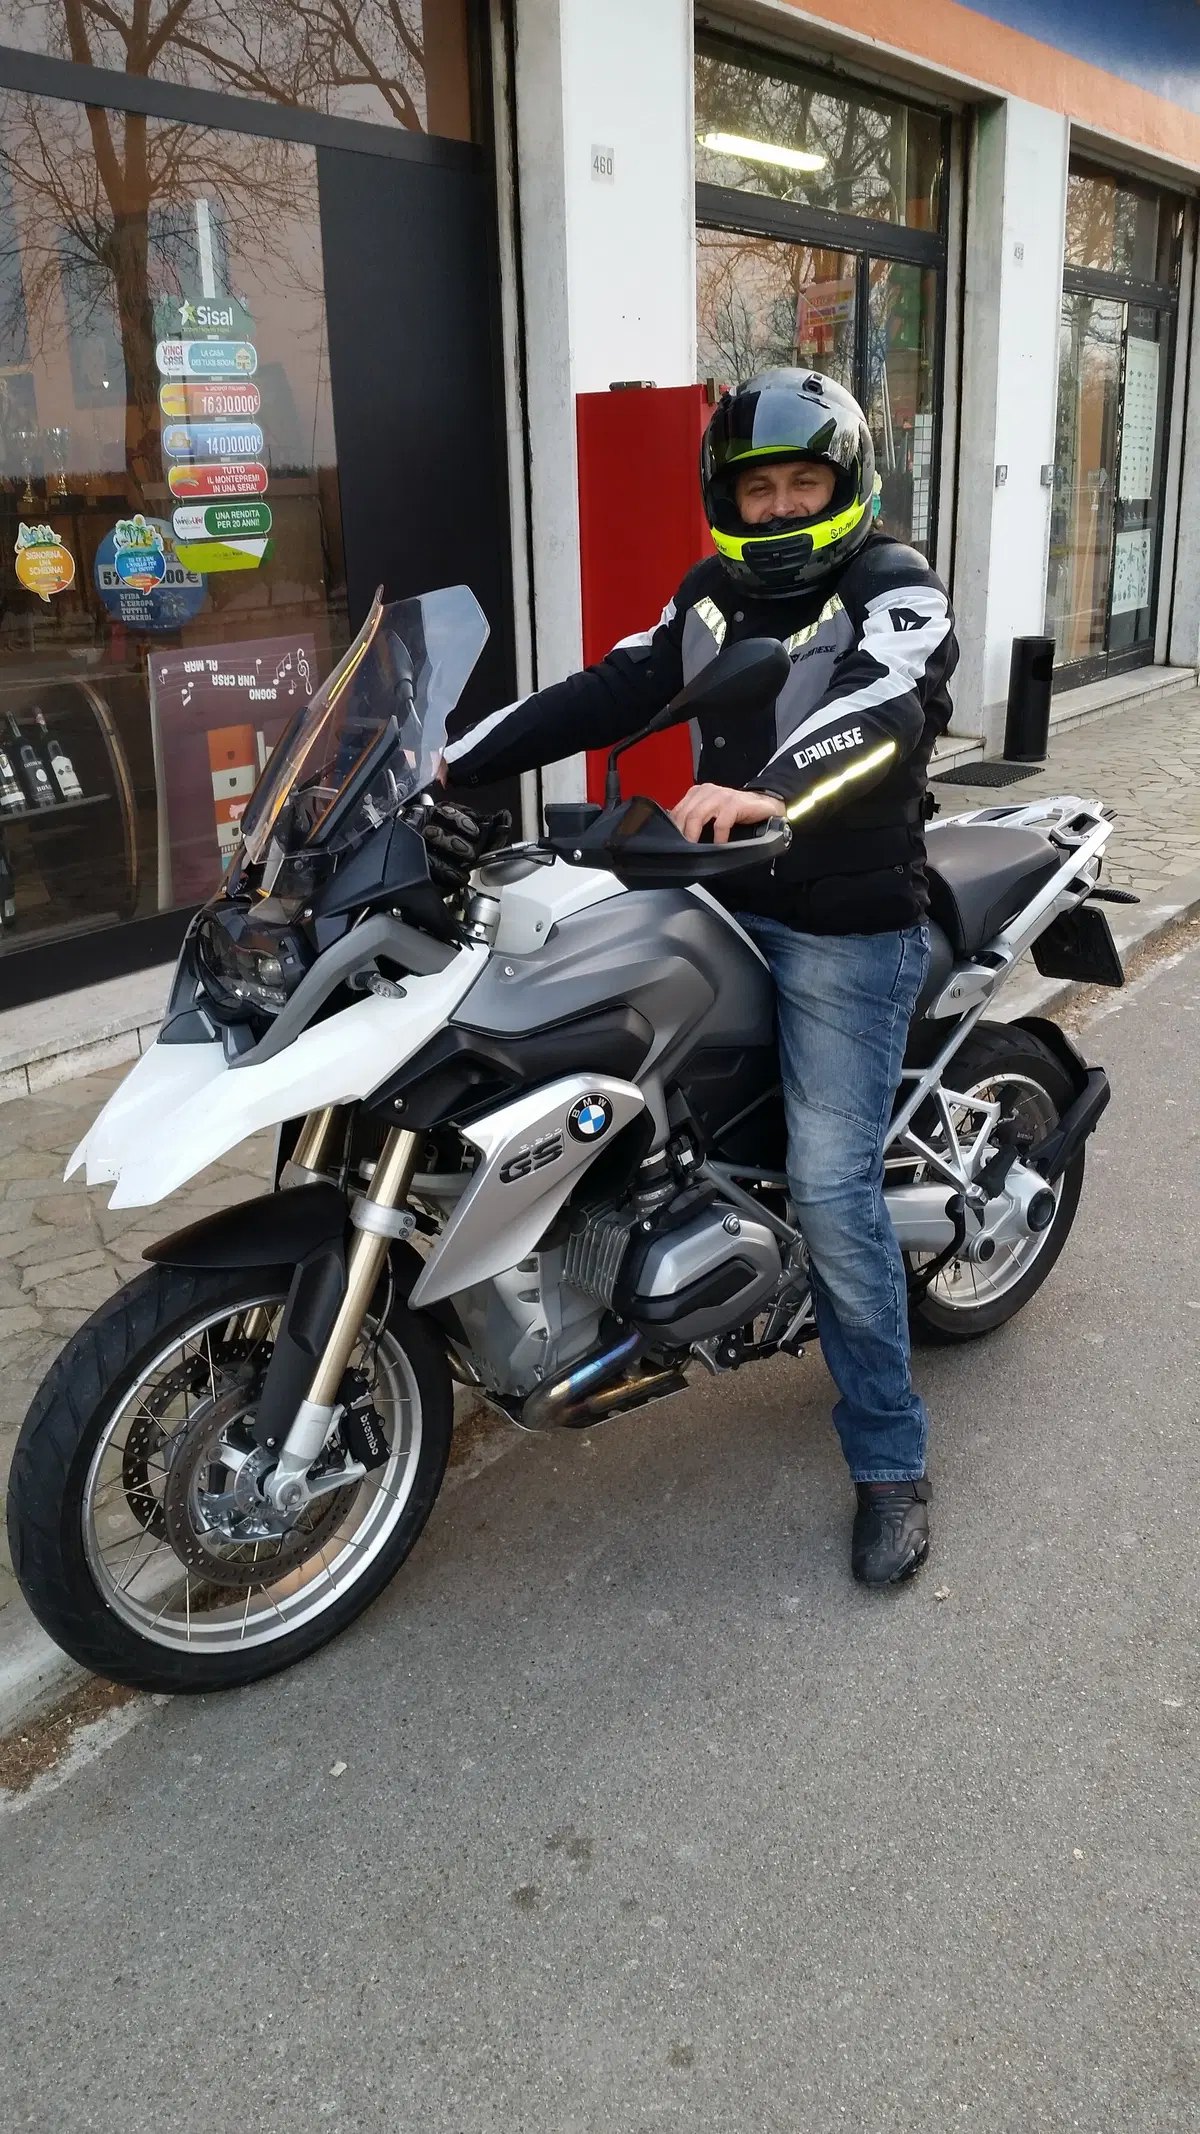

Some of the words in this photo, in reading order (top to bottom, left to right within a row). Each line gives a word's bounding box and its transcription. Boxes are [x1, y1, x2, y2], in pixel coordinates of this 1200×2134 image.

[593, 155, 613, 175] 460
[196, 305, 233, 326] Sisal
[163, 355, 184, 365] CASA
[221, 466, 245, 474] TUTTO
[207, 476, 214, 484] IL
[215, 474, 260, 484] MONTEPREMI
[212, 485, 220, 493] IN
[222, 484, 237, 493] UNA
[238, 483, 257, 492] SERA!
[214, 511, 230, 520] UNA
[231, 509, 261, 519] RENDITA
[216, 520, 231, 528] PER
[232, 519, 241, 528] 20
[242, 518, 260, 527] ANNI!
[120, 599, 154, 607] L'EUROPA
[183, 660, 205, 673] MAR
[205, 660, 218, 672] AL
[212, 674, 235, 686] CASA
[238, 674, 256, 686] UNA
[249, 688, 277, 700] SOGNO
[792, 726, 864, 769] DAINESE
[499, 1134, 564, 1183] GS
[360, 1412, 379, 1455] brembo
